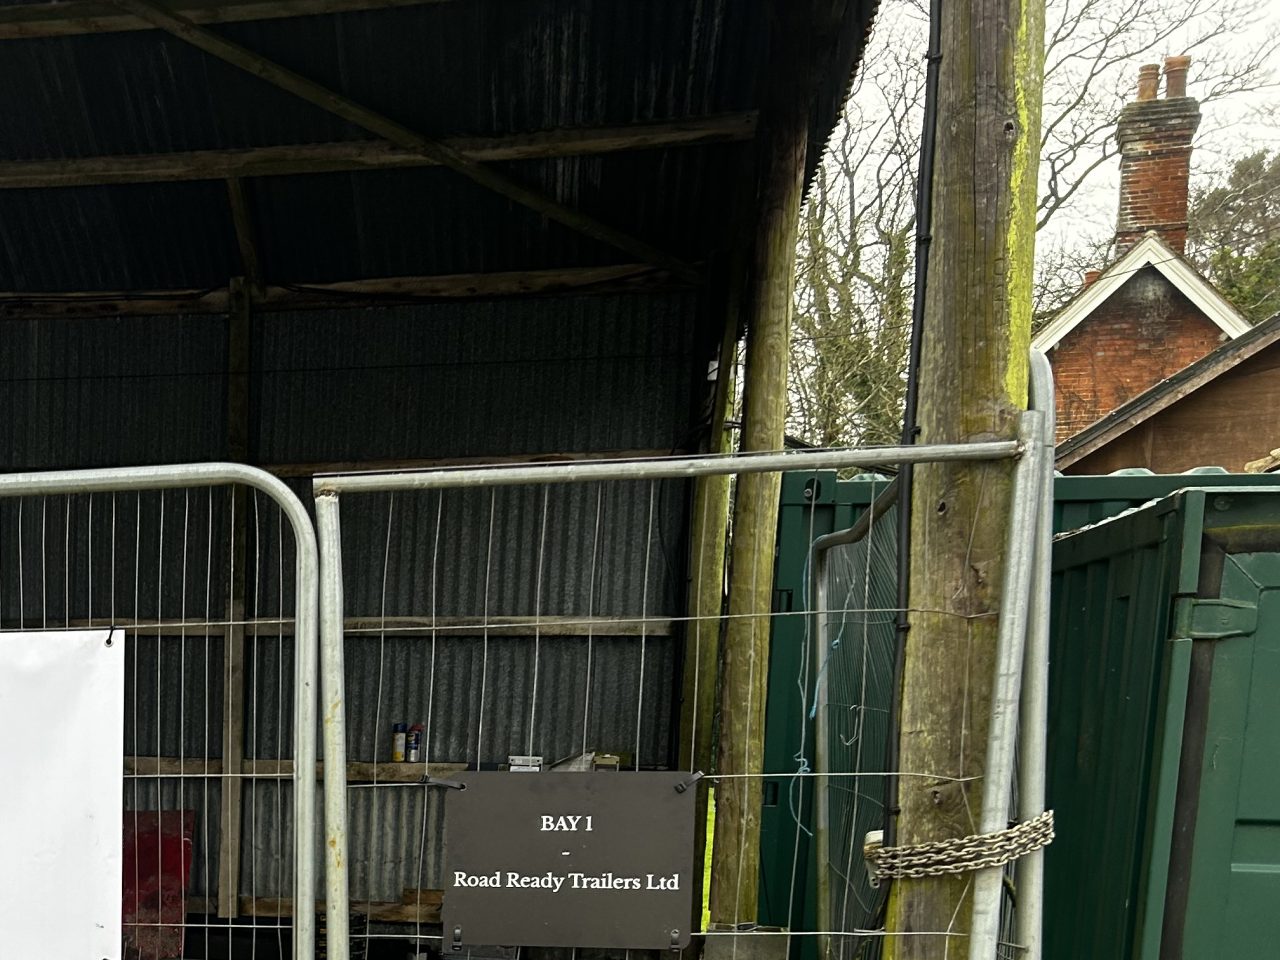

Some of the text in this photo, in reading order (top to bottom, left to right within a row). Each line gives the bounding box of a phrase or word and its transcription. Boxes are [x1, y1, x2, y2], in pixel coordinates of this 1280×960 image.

[540, 815, 594, 832] BAY 1
[453, 871, 680, 893] Road Ready Trailers Ltd
